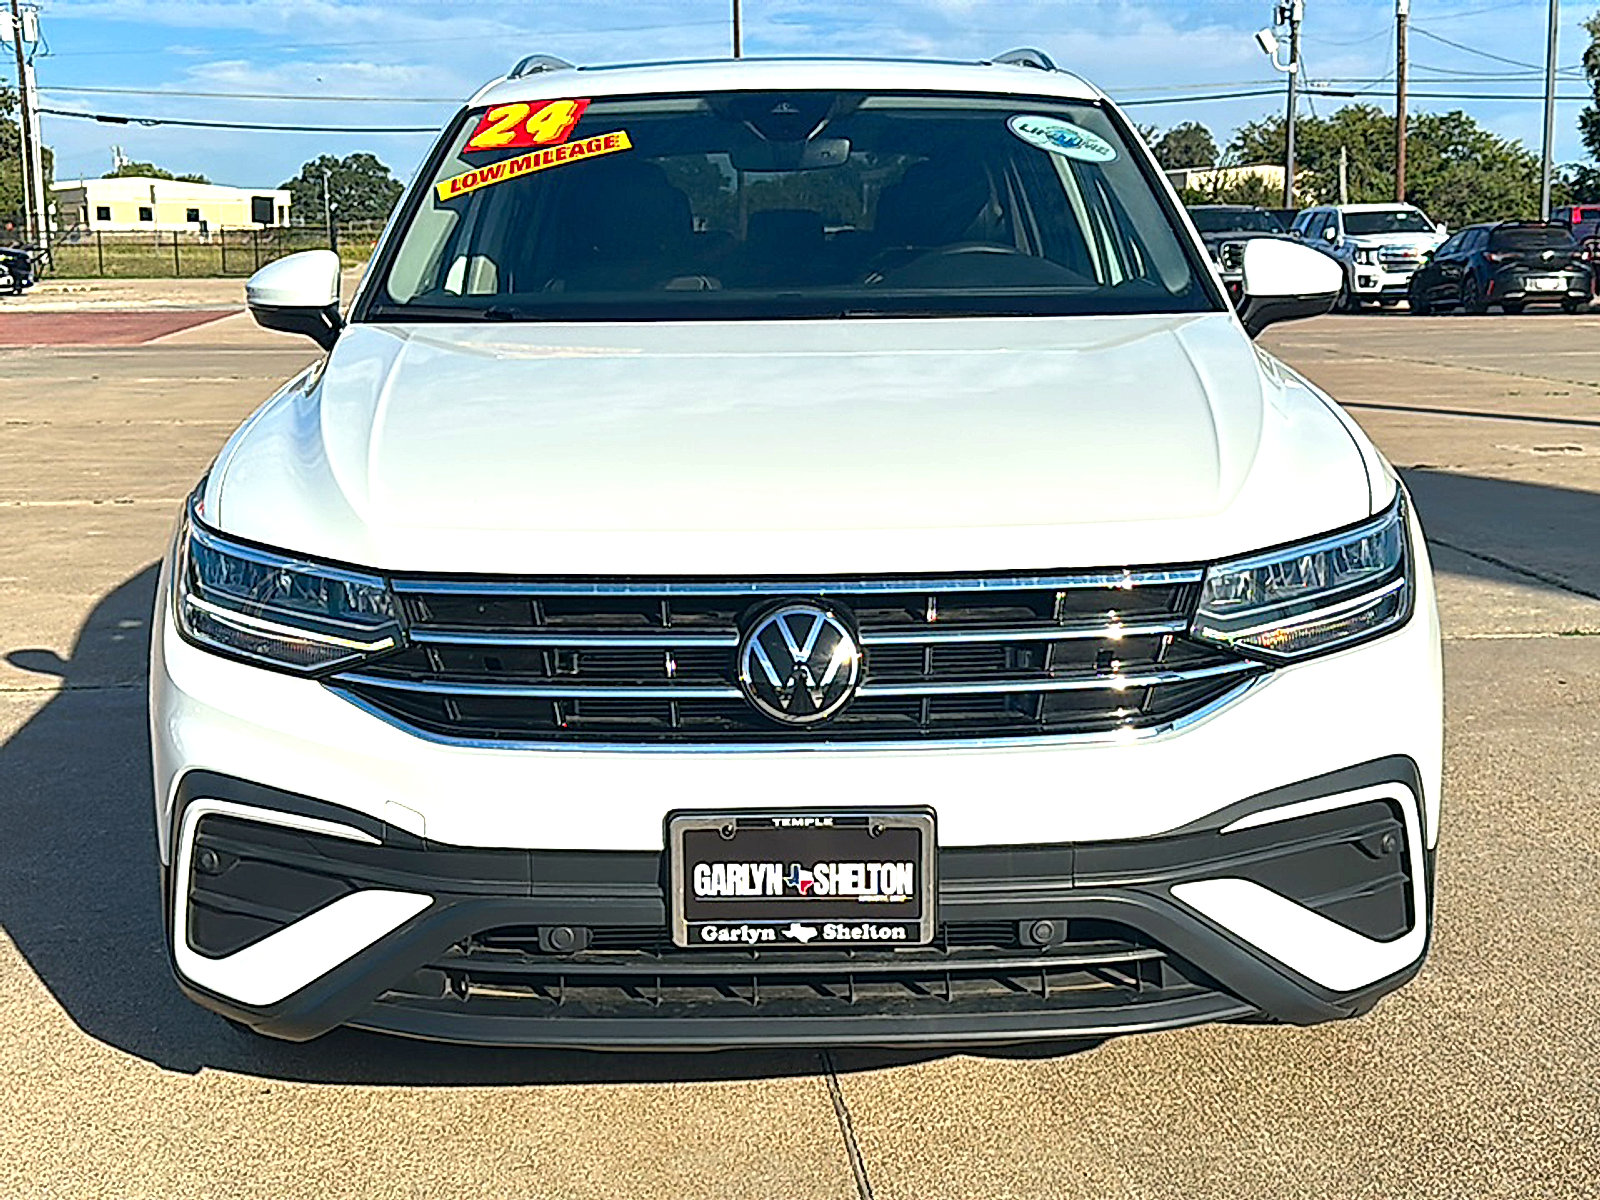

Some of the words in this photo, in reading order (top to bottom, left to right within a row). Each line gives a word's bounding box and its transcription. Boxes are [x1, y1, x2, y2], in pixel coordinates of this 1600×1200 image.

[469, 99, 579, 148] 24
[450, 163, 504, 194] LOW
[509, 134, 620, 175] MILEAGE
[771, 817, 834, 828] TEMPLE
[693, 862, 784, 897] GARLYN
[812, 862, 914, 896] SHELTON
[701, 924, 777, 944] Garlyn
[822, 923, 907, 941] Shelton
